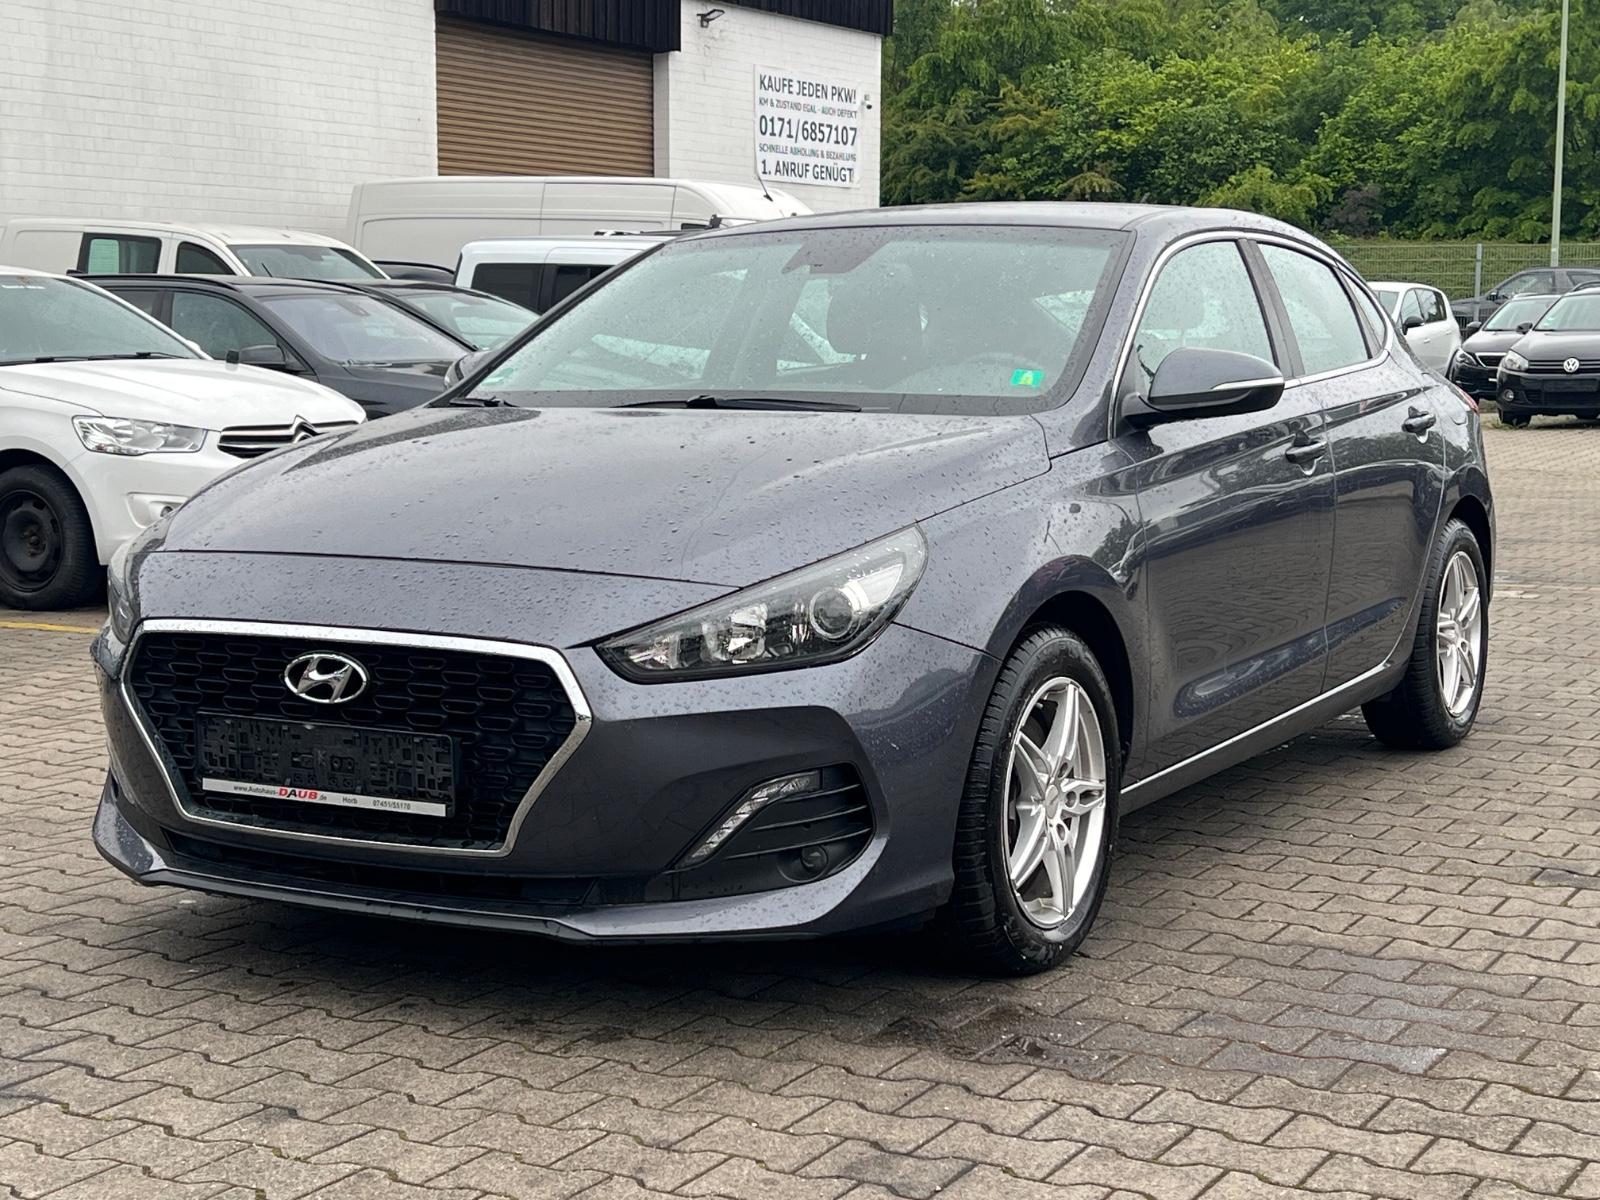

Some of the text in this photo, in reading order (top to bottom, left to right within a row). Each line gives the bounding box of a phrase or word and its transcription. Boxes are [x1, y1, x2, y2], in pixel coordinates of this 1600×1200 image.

[759, 73, 857, 104] KAUFE JEDEN PKW!
[759, 97, 768, 106] KM
[769, 98, 775, 108] &
[775, 99, 802, 111] ZUSTAND
[802, 103, 817, 114] EGAL
[821, 106, 836, 116] AUCH
[837, 108, 857, 119] DEFEKT
[759, 114, 857, 146] 0171/6857107
[759, 143, 788, 154] SCHNELLE
[790, 146, 820, 158] ABHOLUNG
[826, 150, 856, 162] BEZAHLUNG
[761, 159, 771, 175] 1.
[774, 160, 810, 178] ANRUF
